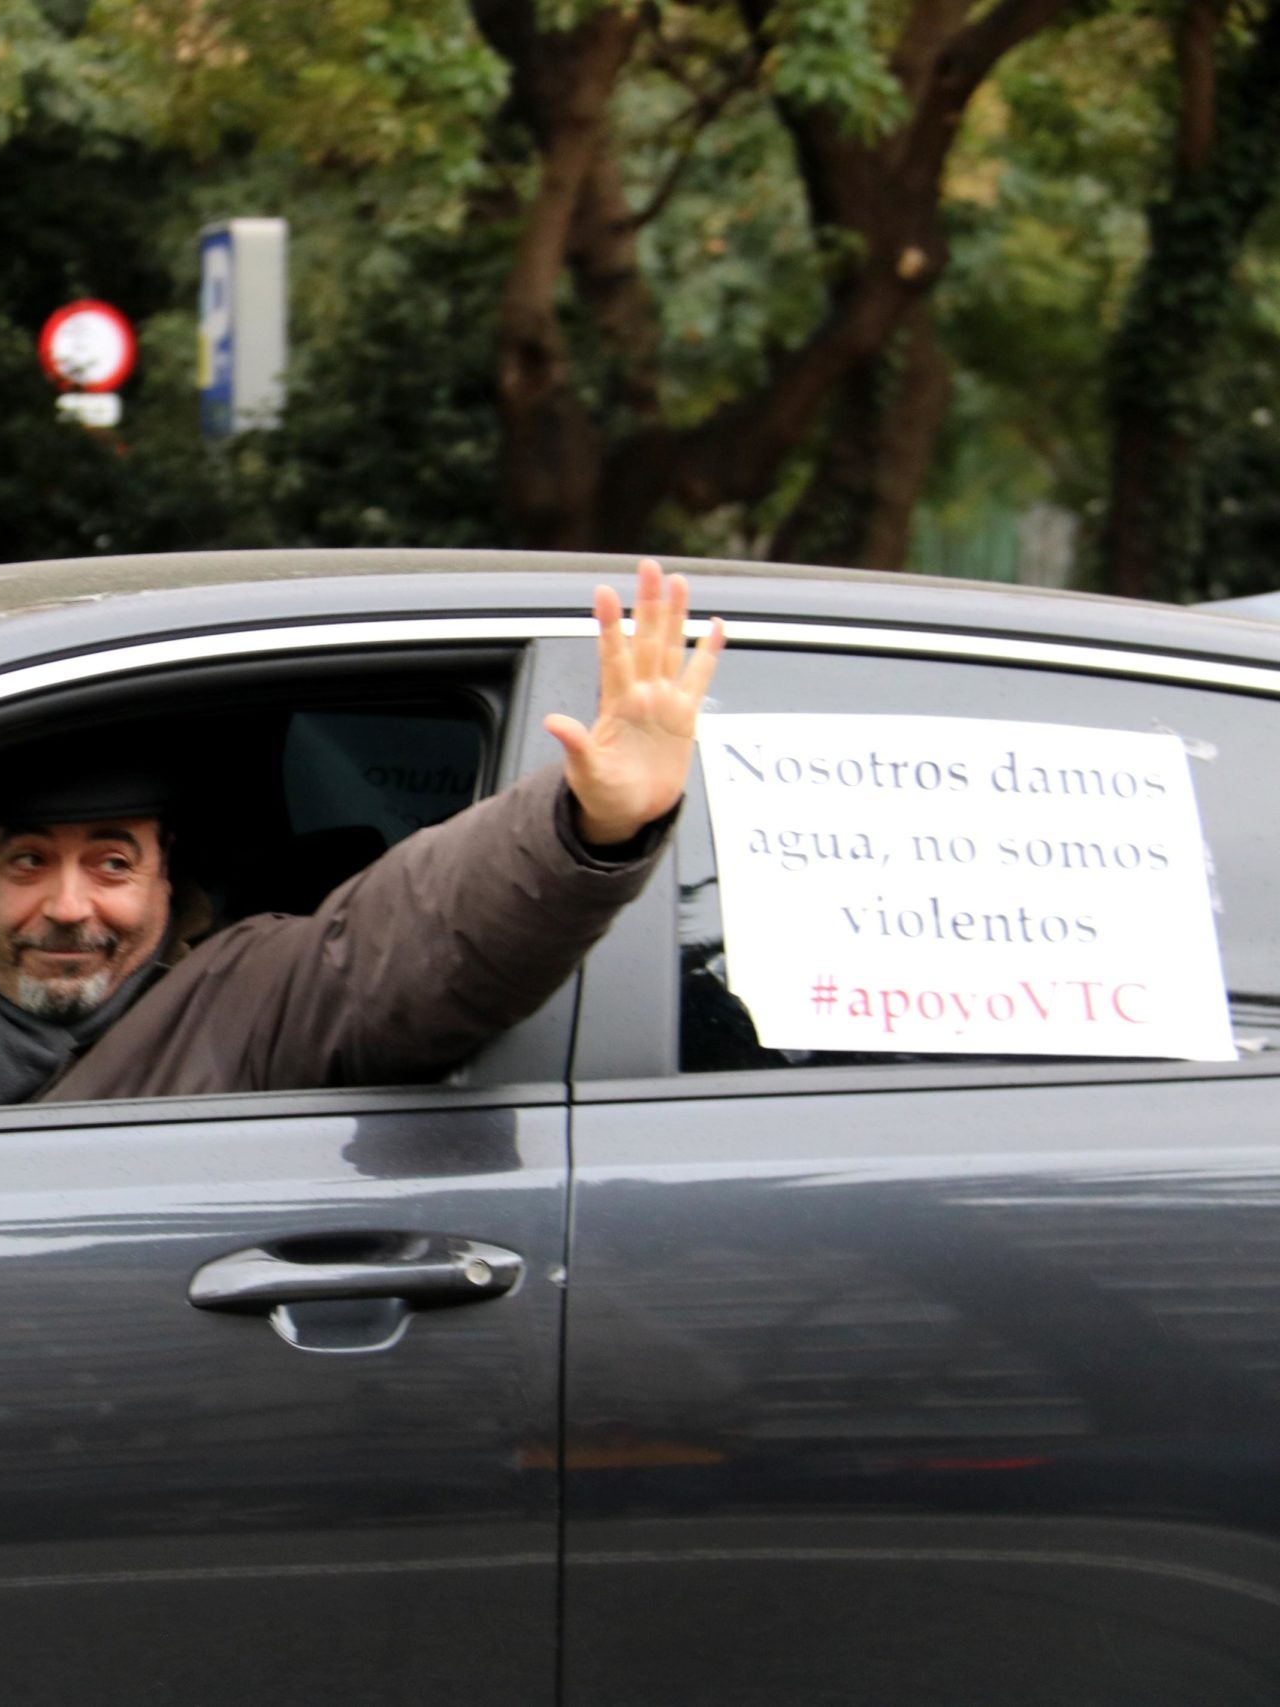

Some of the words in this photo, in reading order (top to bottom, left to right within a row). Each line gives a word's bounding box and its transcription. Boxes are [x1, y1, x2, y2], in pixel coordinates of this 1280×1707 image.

[722, 742, 970, 791] Nosotros
[990, 750, 1167, 799] damos
[748, 827, 891, 871] agua,
[911, 834, 978, 864] no
[997, 838, 1170, 870] somos
[840, 895, 1099, 944] violentos
[809, 974, 1150, 1035] #apoyoVTC
